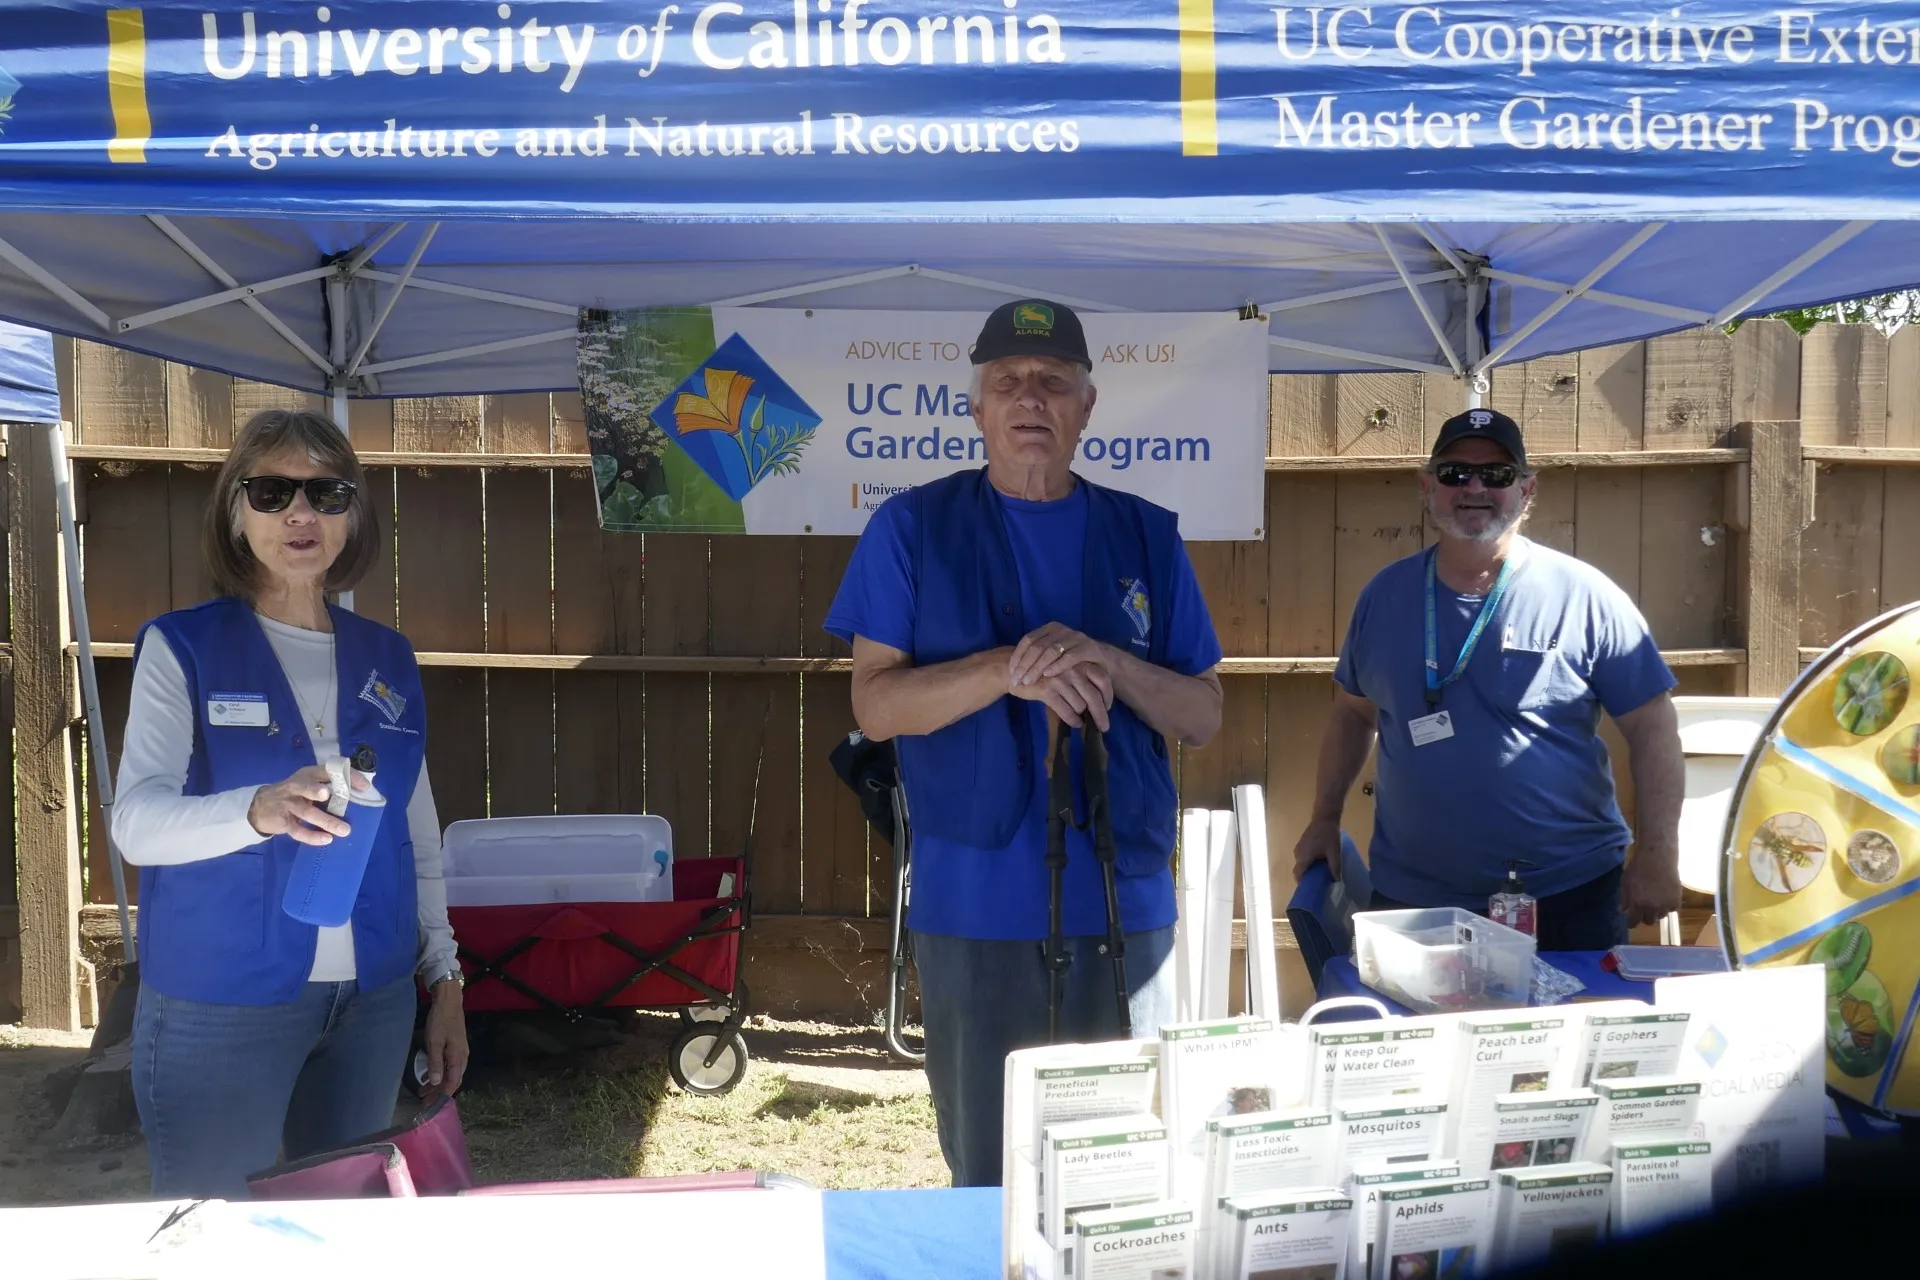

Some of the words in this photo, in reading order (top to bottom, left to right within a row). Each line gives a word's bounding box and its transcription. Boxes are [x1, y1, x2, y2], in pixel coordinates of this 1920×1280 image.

[202, 5, 595, 93] University
[616, 5, 680, 77] of
[692, 0, 1067, 69] California
[1271, 7, 1373, 60] UC
[1395, 7, 1754, 76] Cooperative
[1273, 96, 1481, 149] Master
[1499, 96, 1774, 151] Gardener
[205, 118, 507, 171] Agriculture
[515, 114, 609, 158] and
[625, 109, 815, 157] Natural
[831, 112, 1080, 155] Resources
[1015, 328, 1051, 338] ALASKA
[845, 341, 922, 361] ADVICE
[929, 342, 960, 362] TO
[1101, 344, 1138, 363] ASK
[1146, 344, 1177, 363] US!
[847, 382, 903, 416] UC
[914, 384, 973, 417] Ma
[845, 426, 989, 460] Garden
[1079, 436, 1210, 471] ogram
[1478, 1036, 1517, 1048] Peach
[1520, 1032, 1549, 1045] Leaf
[1607, 1030, 1658, 1043] Gophers
[1184, 1042, 1214, 1054] What
[1344, 1047, 1374, 1059] Keep
[1377, 1045, 1399, 1055] Our
[1476, 1049, 1503, 1061] Curl
[1343, 1061, 1380, 1072] Water
[1383, 1058, 1415, 1068] Clean
[1045, 1079, 1099, 1090] Beneficial
[1699, 1077, 1747, 1101] OCIAL
[1045, 1089, 1098, 1099] Predators
[1612, 1101, 1652, 1111] Common
[1654, 1099, 1686, 1108] Garden
[1500, 1115, 1529, 1125] Snails
[1532, 1113, 1550, 1122] and
[1554, 1112, 1580, 1122] Slugs
[1610, 1111, 1644, 1122] Spiders
[1347, 1119, 1421, 1136] Mosquitos
[1236, 1137, 1260, 1148] Less
[1263, 1133, 1292, 1145] Toxic
[1064, 1154, 1090, 1164] Lady
[1093, 1149, 1133, 1160] Beetles
[1235, 1145, 1300, 1160] Insecticides
[1626, 1160, 1668, 1171] Parasites
[1669, 1159, 1679, 1167] of
[1626, 1173, 1654, 1183] Insect
[1655, 1172, 1680, 1181] Pests
[1523, 1187, 1603, 1202] Yellowjackets
[1395, 1202, 1444, 1219] Aphids
[1254, 1222, 1289, 1236] Ants
[1093, 1231, 1186, 1253] Cockroaches
